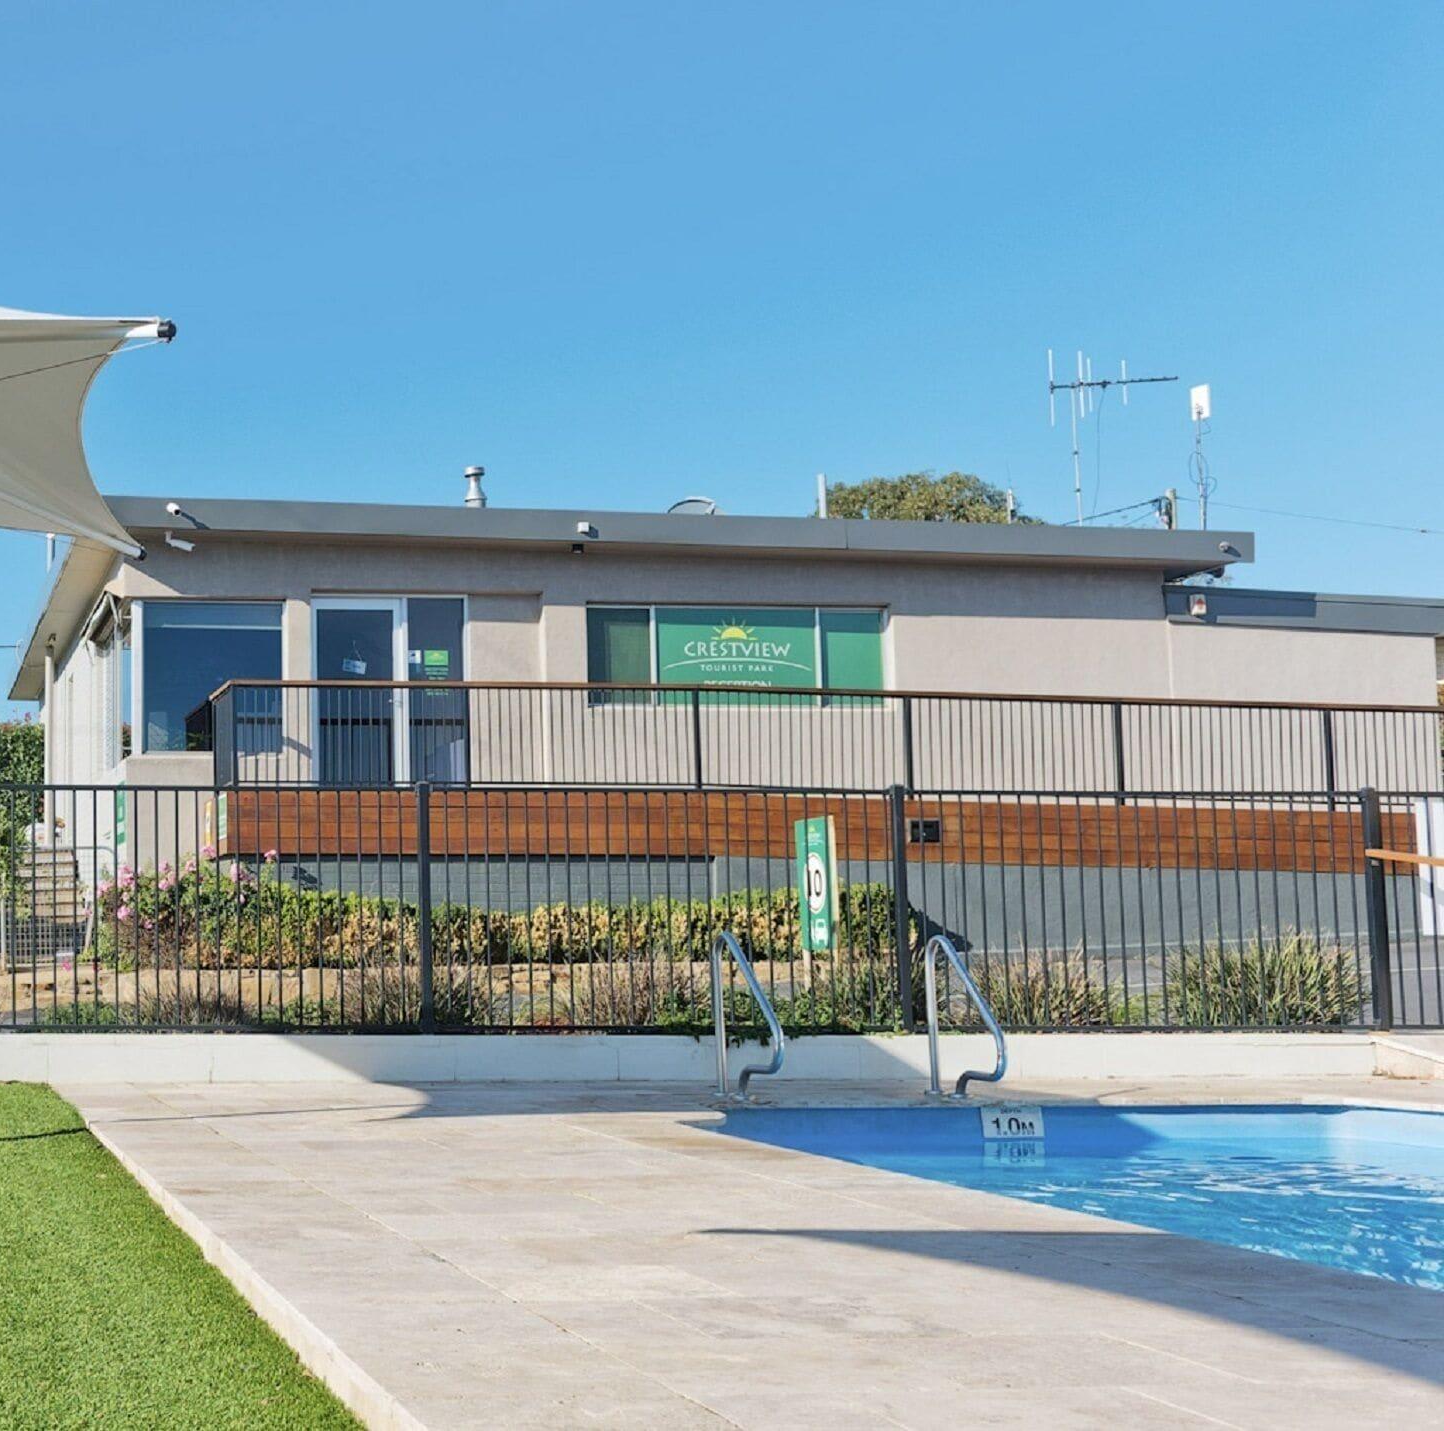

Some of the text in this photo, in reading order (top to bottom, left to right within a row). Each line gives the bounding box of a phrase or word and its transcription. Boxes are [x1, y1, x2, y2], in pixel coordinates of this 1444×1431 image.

[683, 641, 791, 657] CRESTVIEW
[700, 664, 774, 673] TOURIST PARK
